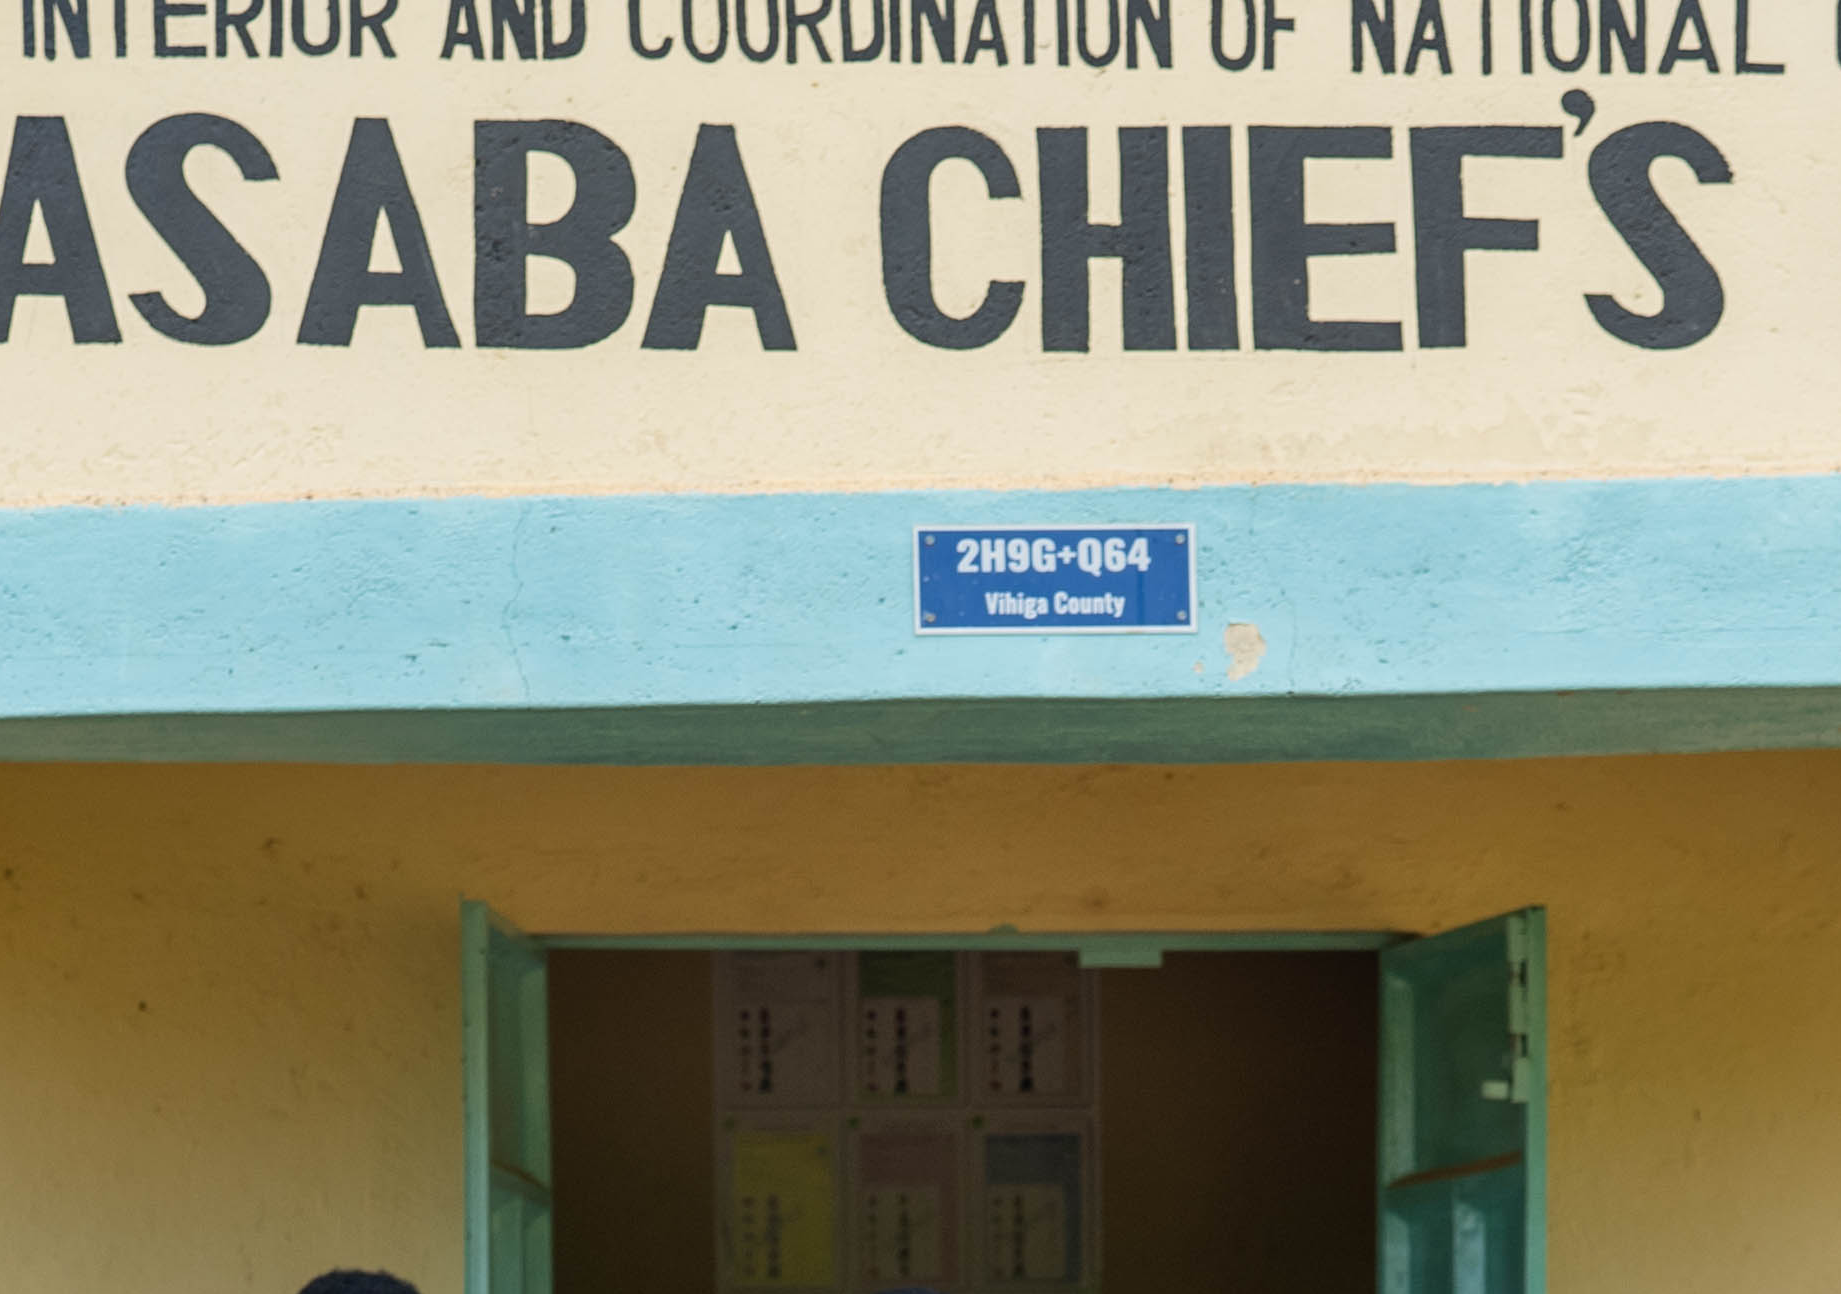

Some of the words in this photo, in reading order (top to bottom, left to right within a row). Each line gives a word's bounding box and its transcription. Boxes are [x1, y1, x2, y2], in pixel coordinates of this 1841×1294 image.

[22, 0, 398, 60] INTERIOR
[440, 0, 587, 61] AND
[627, 0, 1172, 68] COORDINATION
[1210, 0, 1295, 71] OF
[1351, 0, 1785, 75] NATIONAL
[879, 88, 1733, 352] CHIEF'S
[956, 537, 1152, 578] 2H9G+Q64
[985, 591, 1049, 620] Vihiga
[1054, 591, 1126, 618] County
